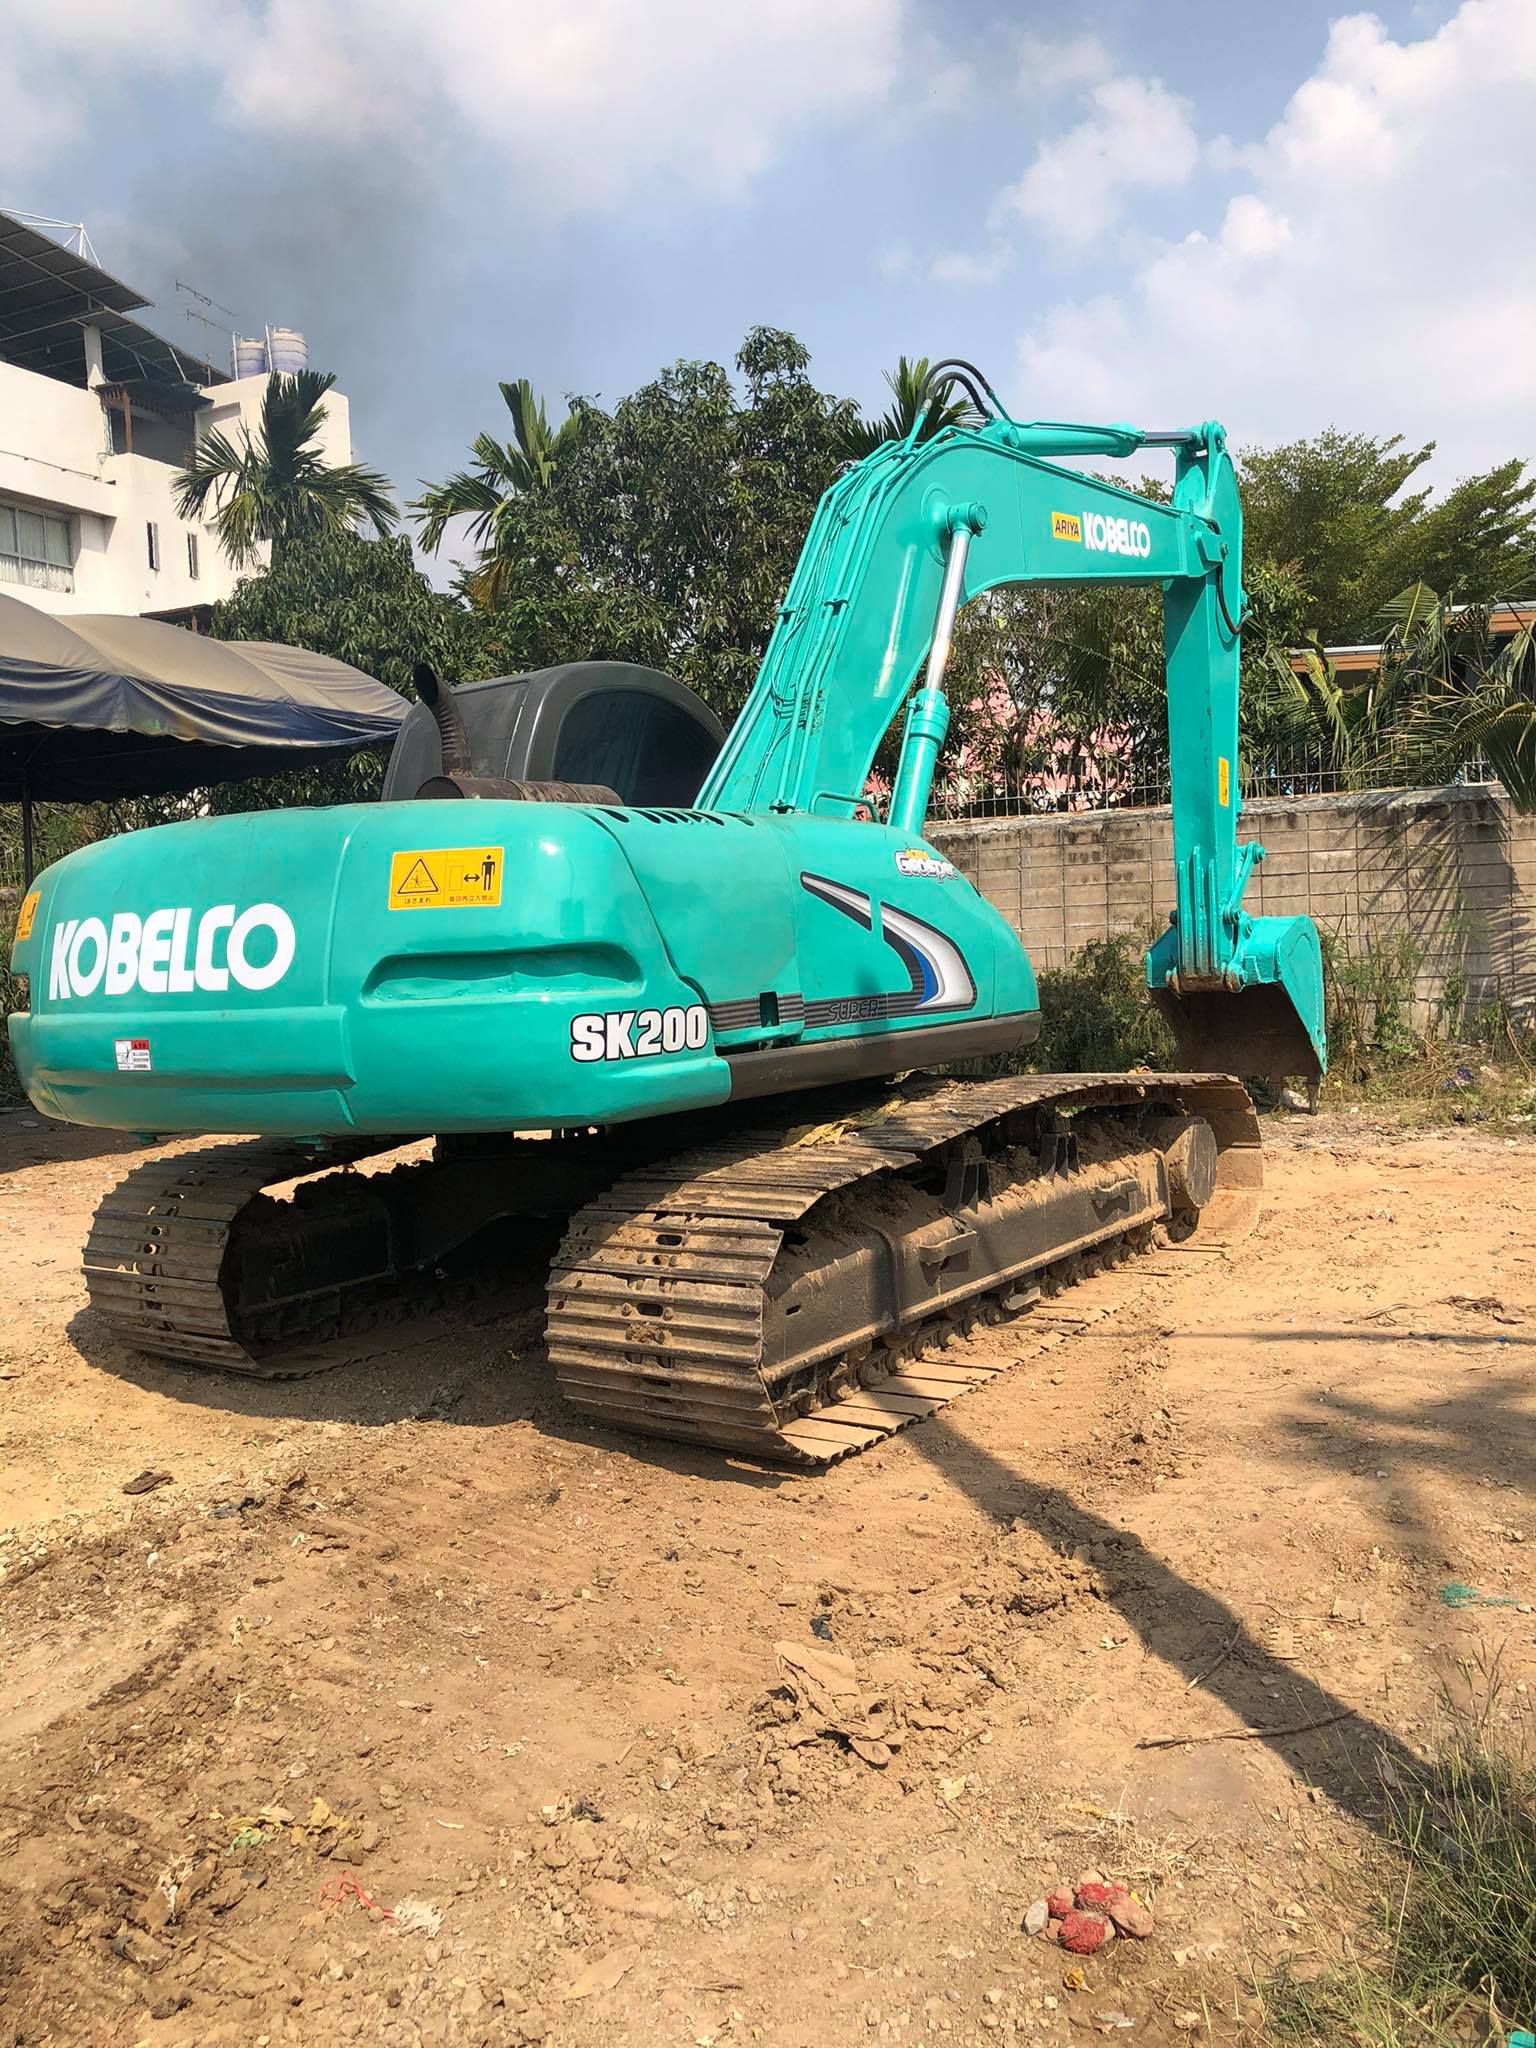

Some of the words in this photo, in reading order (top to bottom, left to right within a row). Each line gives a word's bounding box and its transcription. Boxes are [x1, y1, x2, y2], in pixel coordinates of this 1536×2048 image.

[1054, 519, 1080, 537] ARIYA
[1083, 511, 1151, 558] KOBELCO
[49, 902, 296, 1001] KOBELCO
[570, 1004, 708, 1063] SK200
[826, 1000, 879, 1023] SUPER
